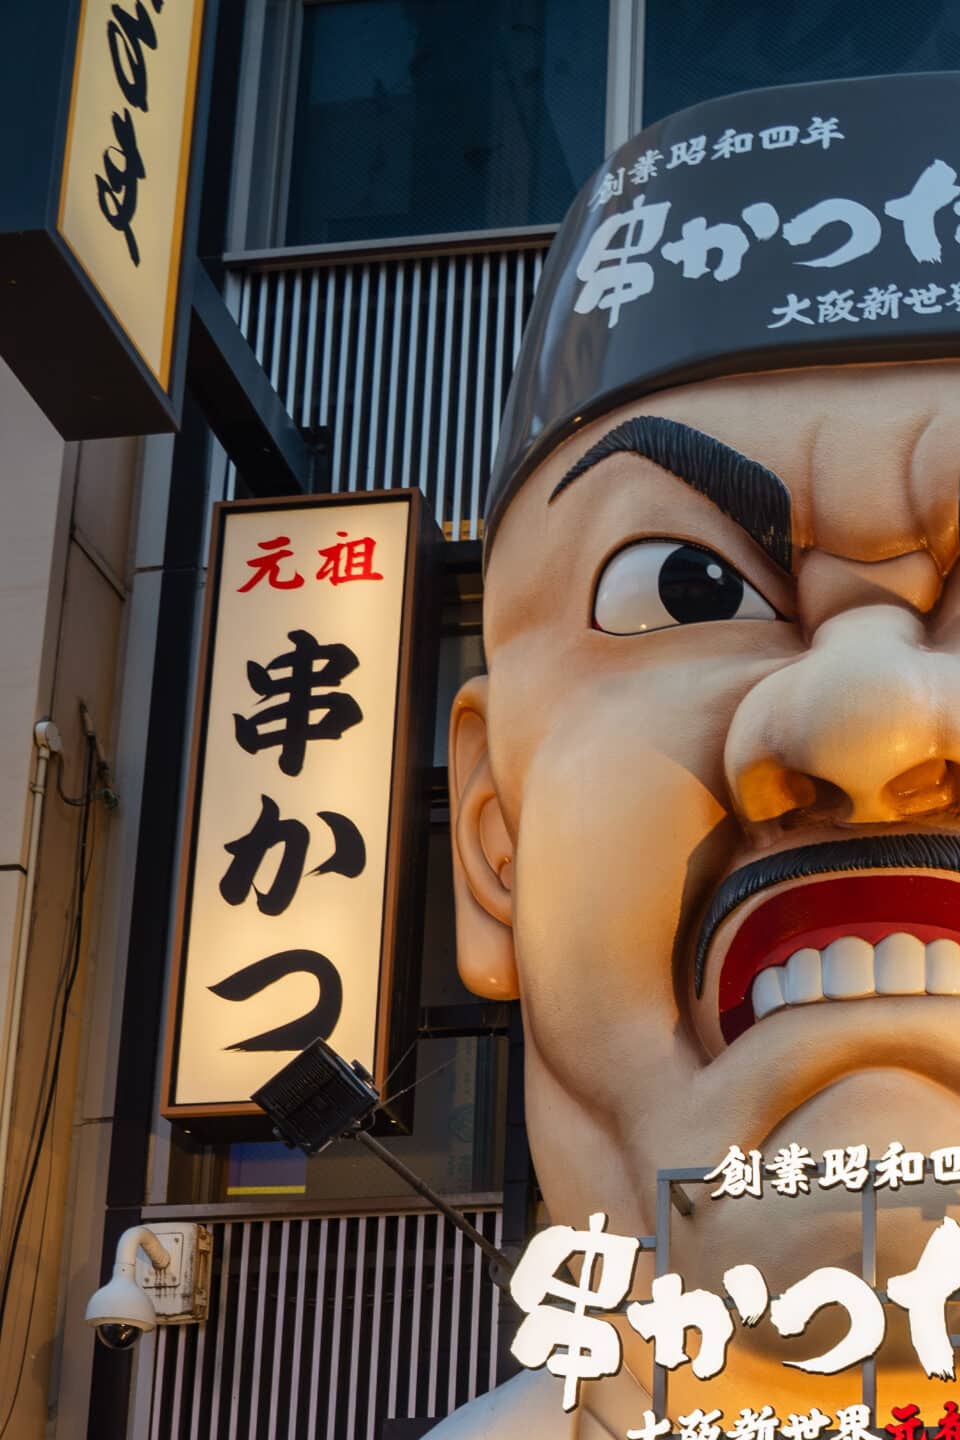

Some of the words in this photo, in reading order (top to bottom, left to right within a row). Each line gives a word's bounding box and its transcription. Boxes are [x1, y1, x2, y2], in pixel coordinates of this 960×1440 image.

[95, 0, 164, 268] るま
[588, 116, 845, 211] 創業昭和四年
[236, 531, 384, 593] 元祖
[207, 628, 367, 1052] 串かつ
